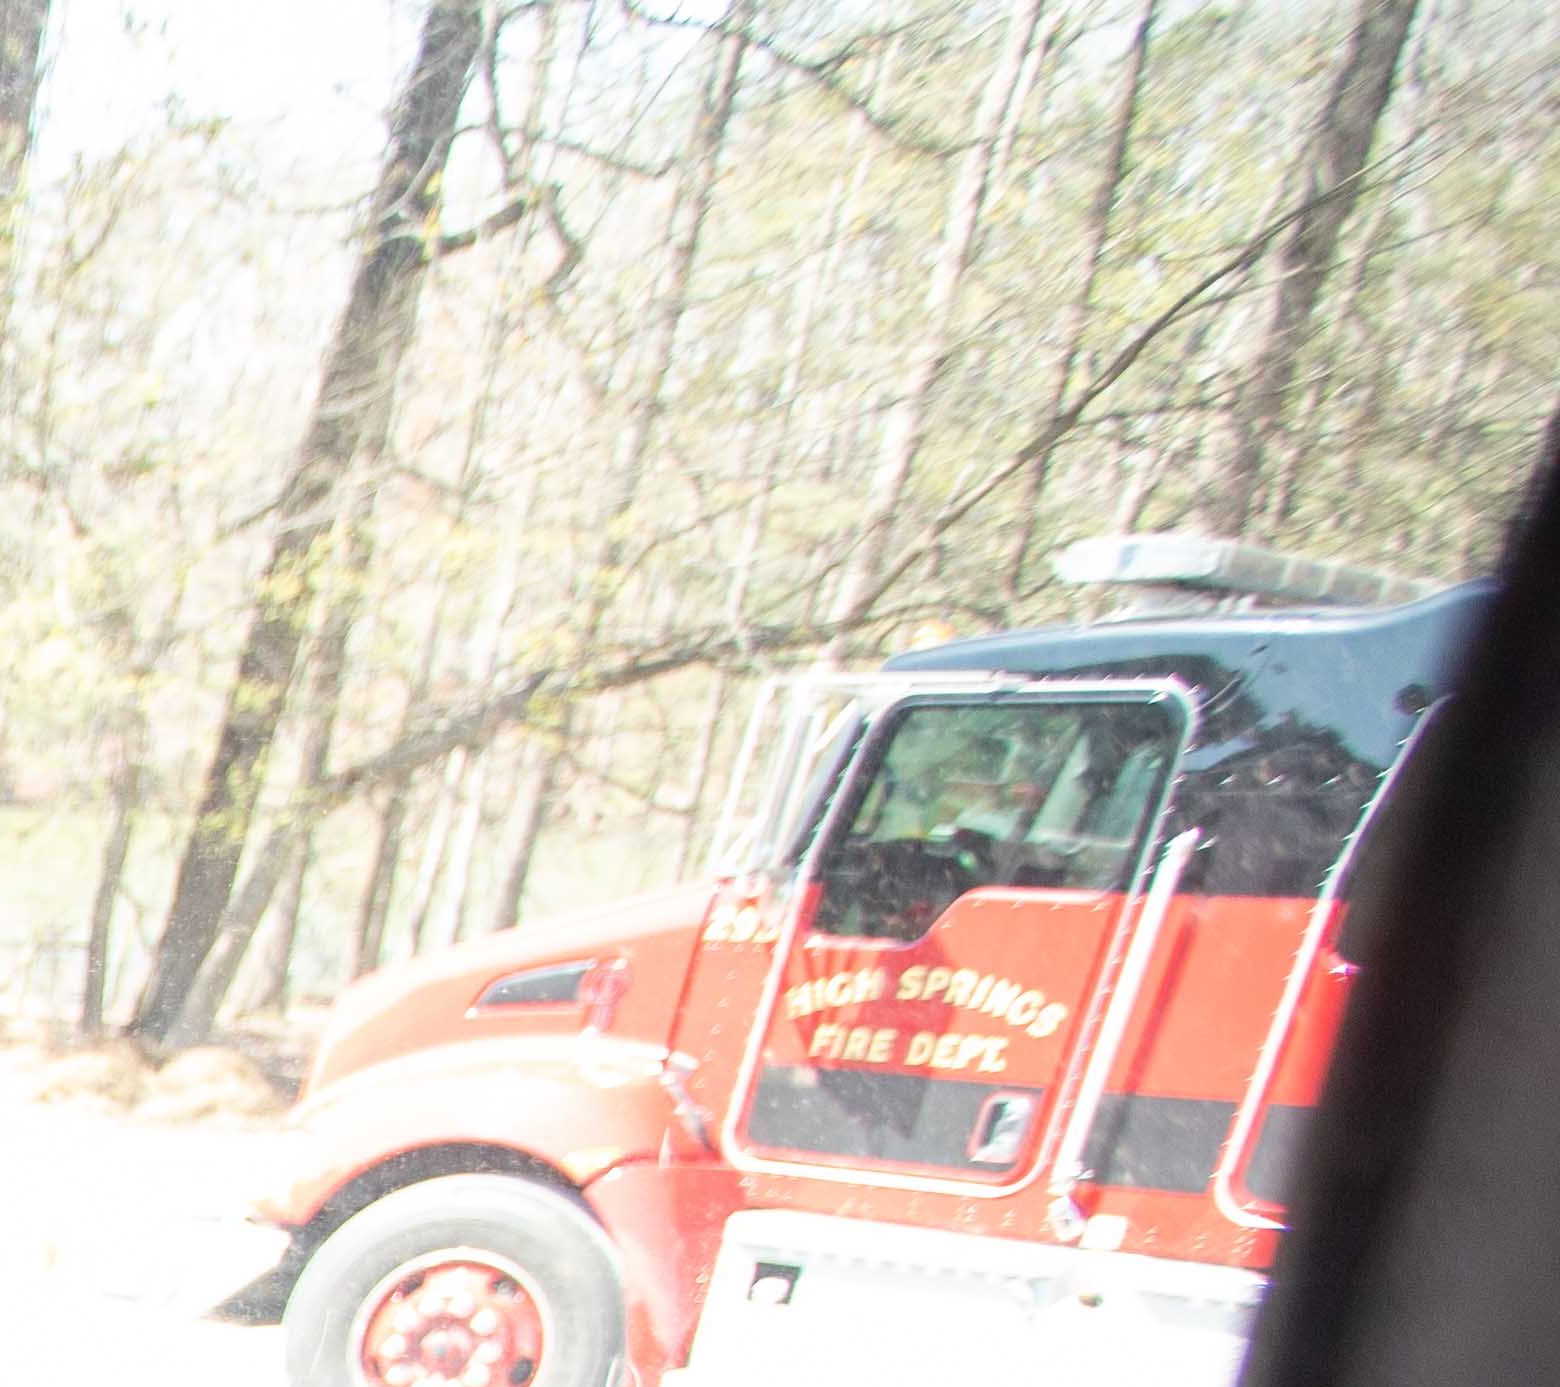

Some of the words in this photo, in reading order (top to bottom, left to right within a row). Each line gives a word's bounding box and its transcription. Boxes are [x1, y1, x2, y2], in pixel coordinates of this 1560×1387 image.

[784, 966, 886, 1021] HIGH
[895, 963, 1069, 1039] SPRINGS
[807, 1022, 898, 1064] FIRE
